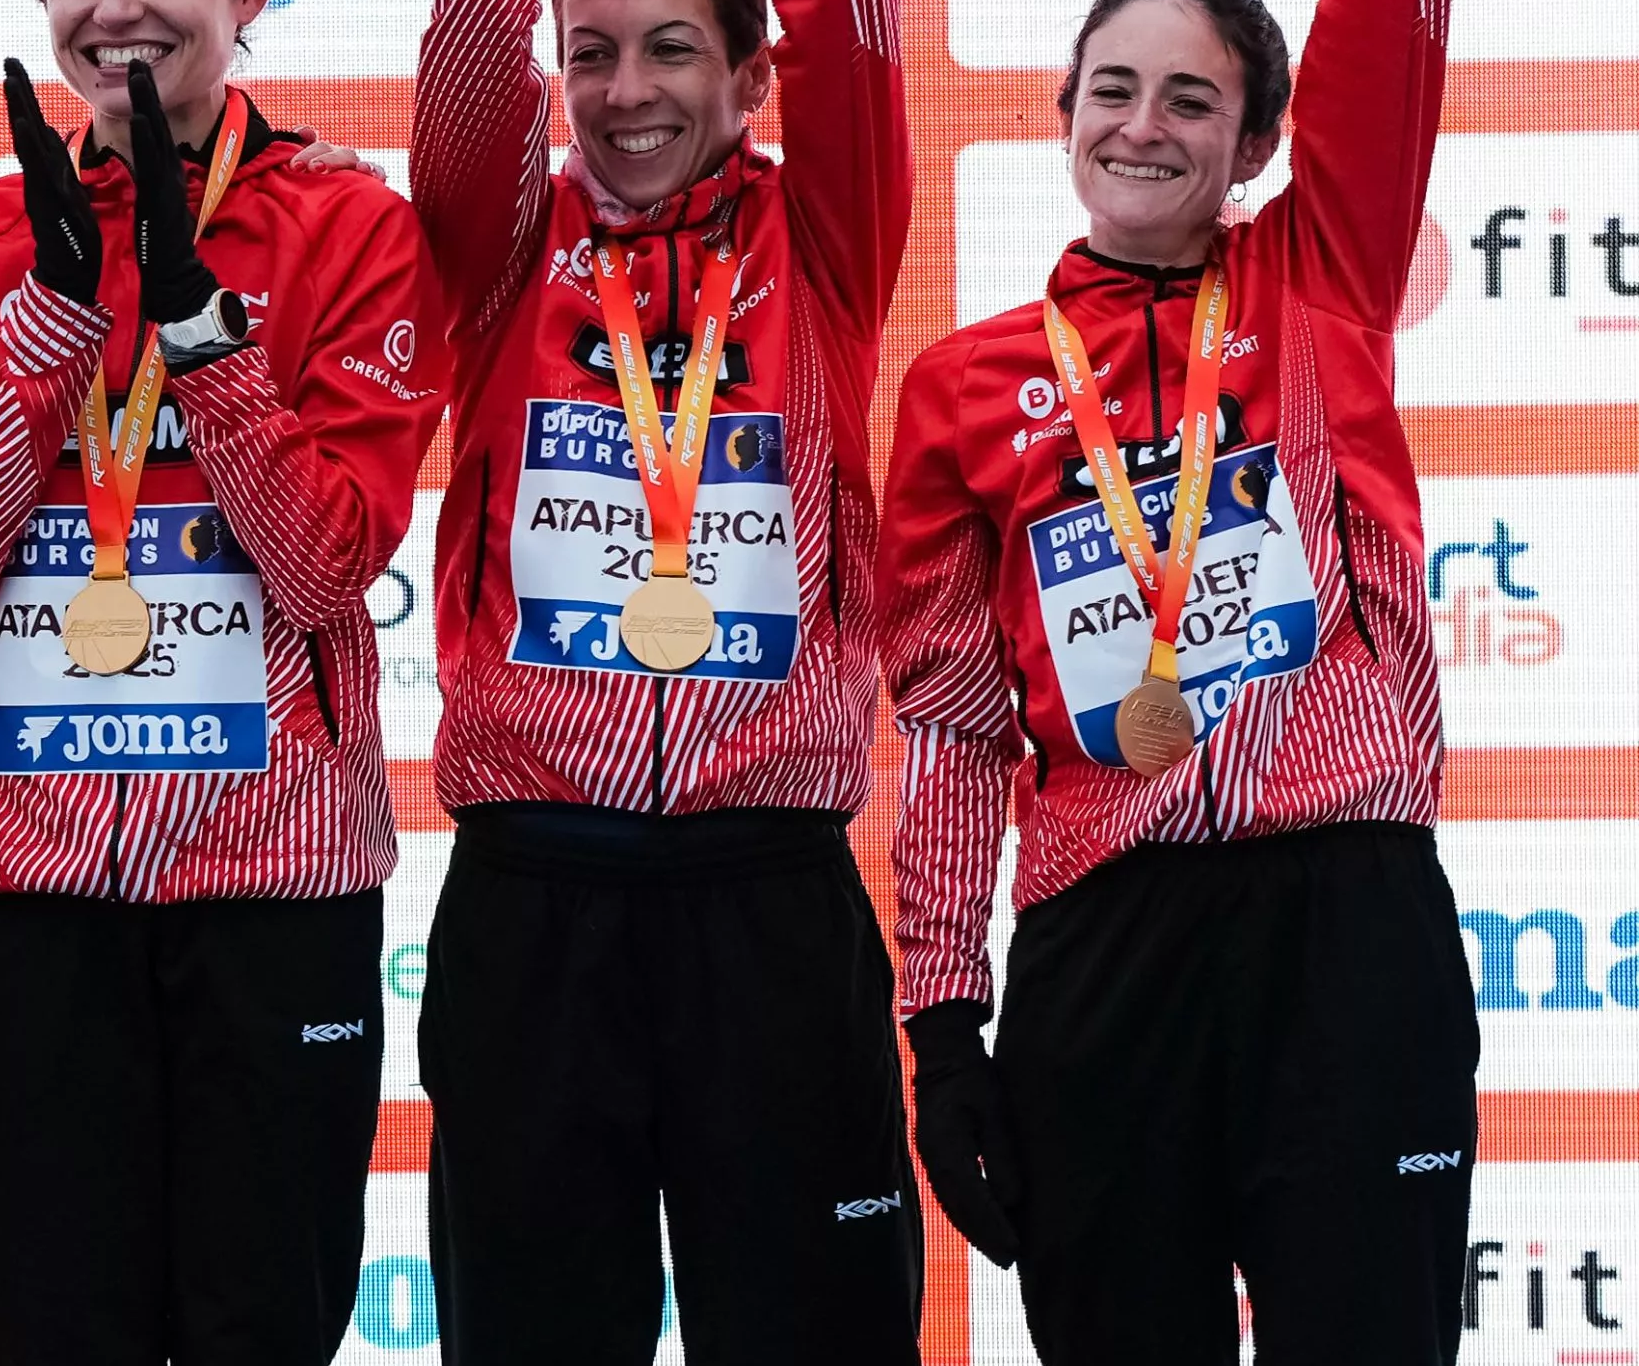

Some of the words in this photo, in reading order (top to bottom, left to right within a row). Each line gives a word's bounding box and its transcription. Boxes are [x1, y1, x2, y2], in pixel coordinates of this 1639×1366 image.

[728, 276, 777, 322] SPORT
[1201, 315, 1215, 360] RFEA
[341, 356, 391, 388] OREKA
[618, 331, 649, 429] ATLETISMO
[680, 411, 698, 468] RFEA
[690, 314, 718, 407] ATLETISMO
[1064, 352, 1084, 395] RFEA
[90, 429, 105, 489] RFEA
[122, 416, 143, 473] RFEA
[540, 438, 638, 469] BURG
[640, 430, 662, 486] RFEA
[1093, 446, 1134, 536] ATLETISMO
[1177, 511, 1194, 567] RFEA
[1188, 411, 1208, 509] ATLETISMO
[1129, 542, 1158, 591] RFEA
[63, 713, 228, 762] Joma
